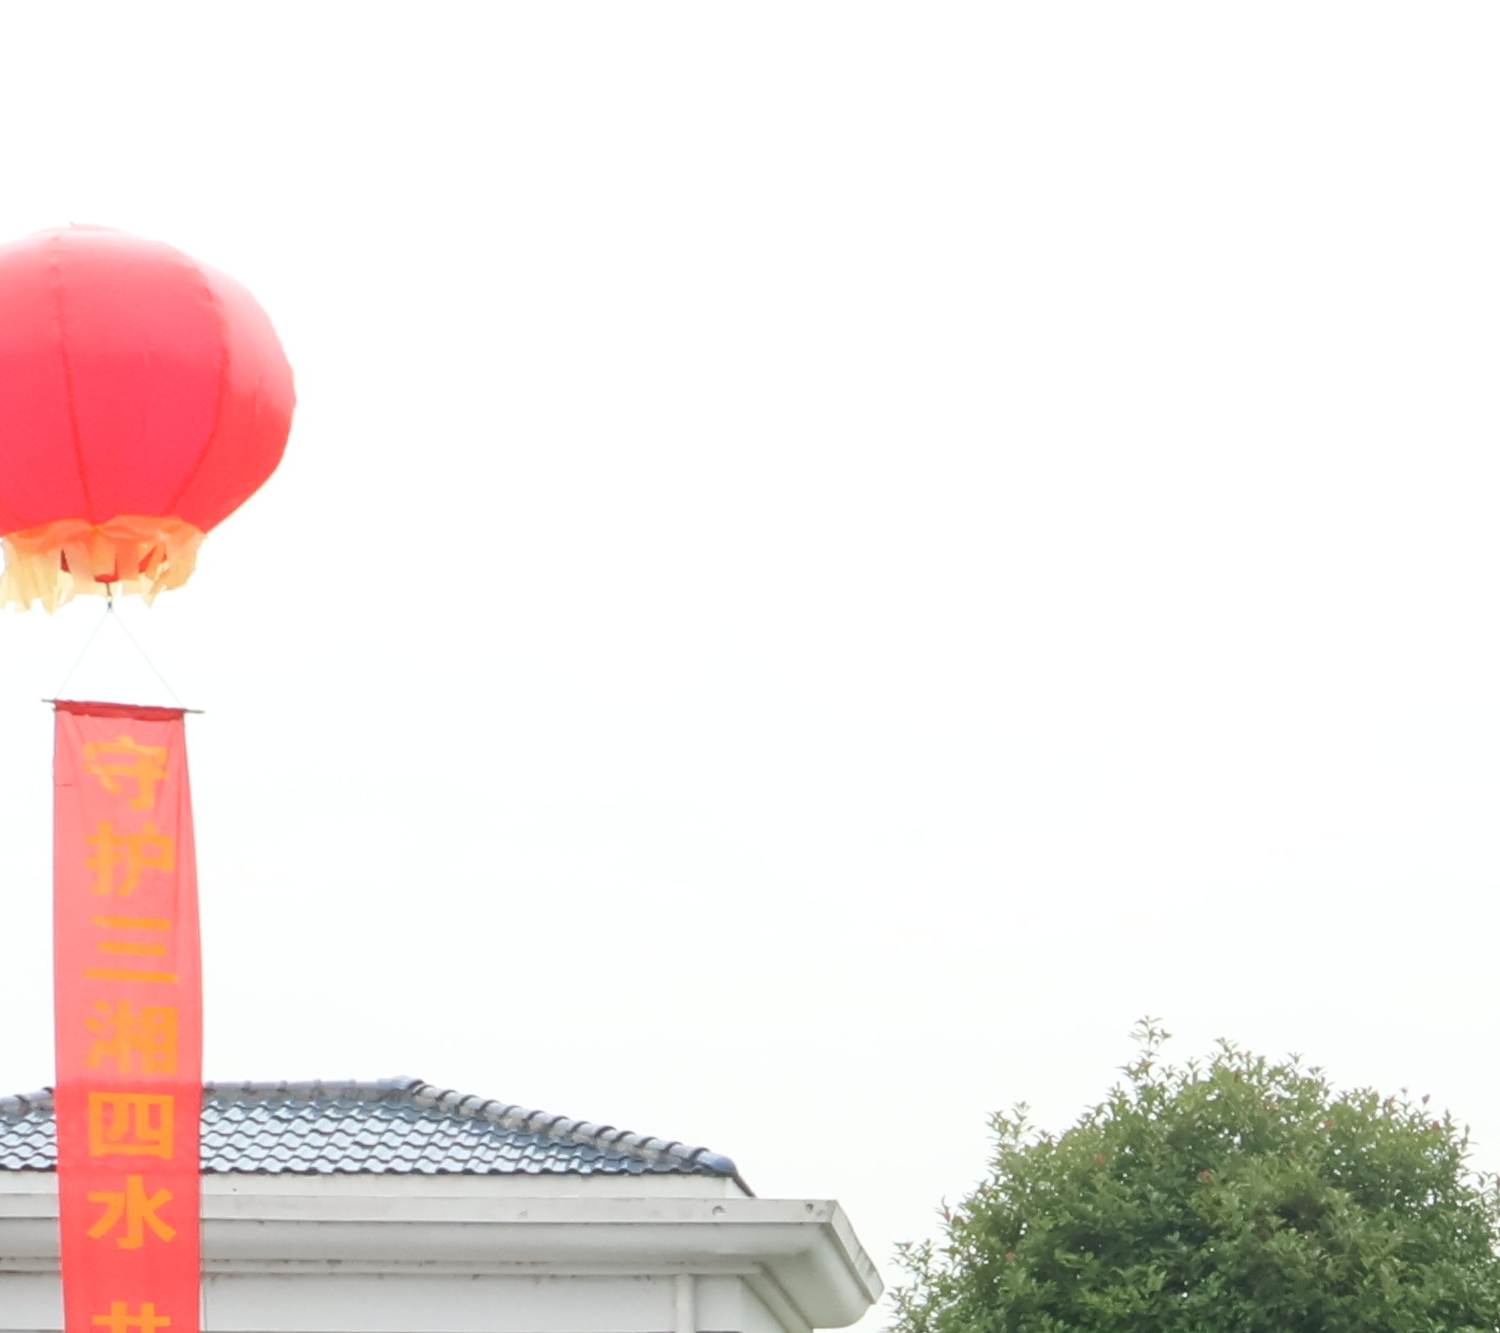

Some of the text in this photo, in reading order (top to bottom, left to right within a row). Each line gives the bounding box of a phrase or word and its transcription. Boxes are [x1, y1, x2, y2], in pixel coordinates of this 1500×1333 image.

[82, 735, 179, 1250] 守护三湘四水
